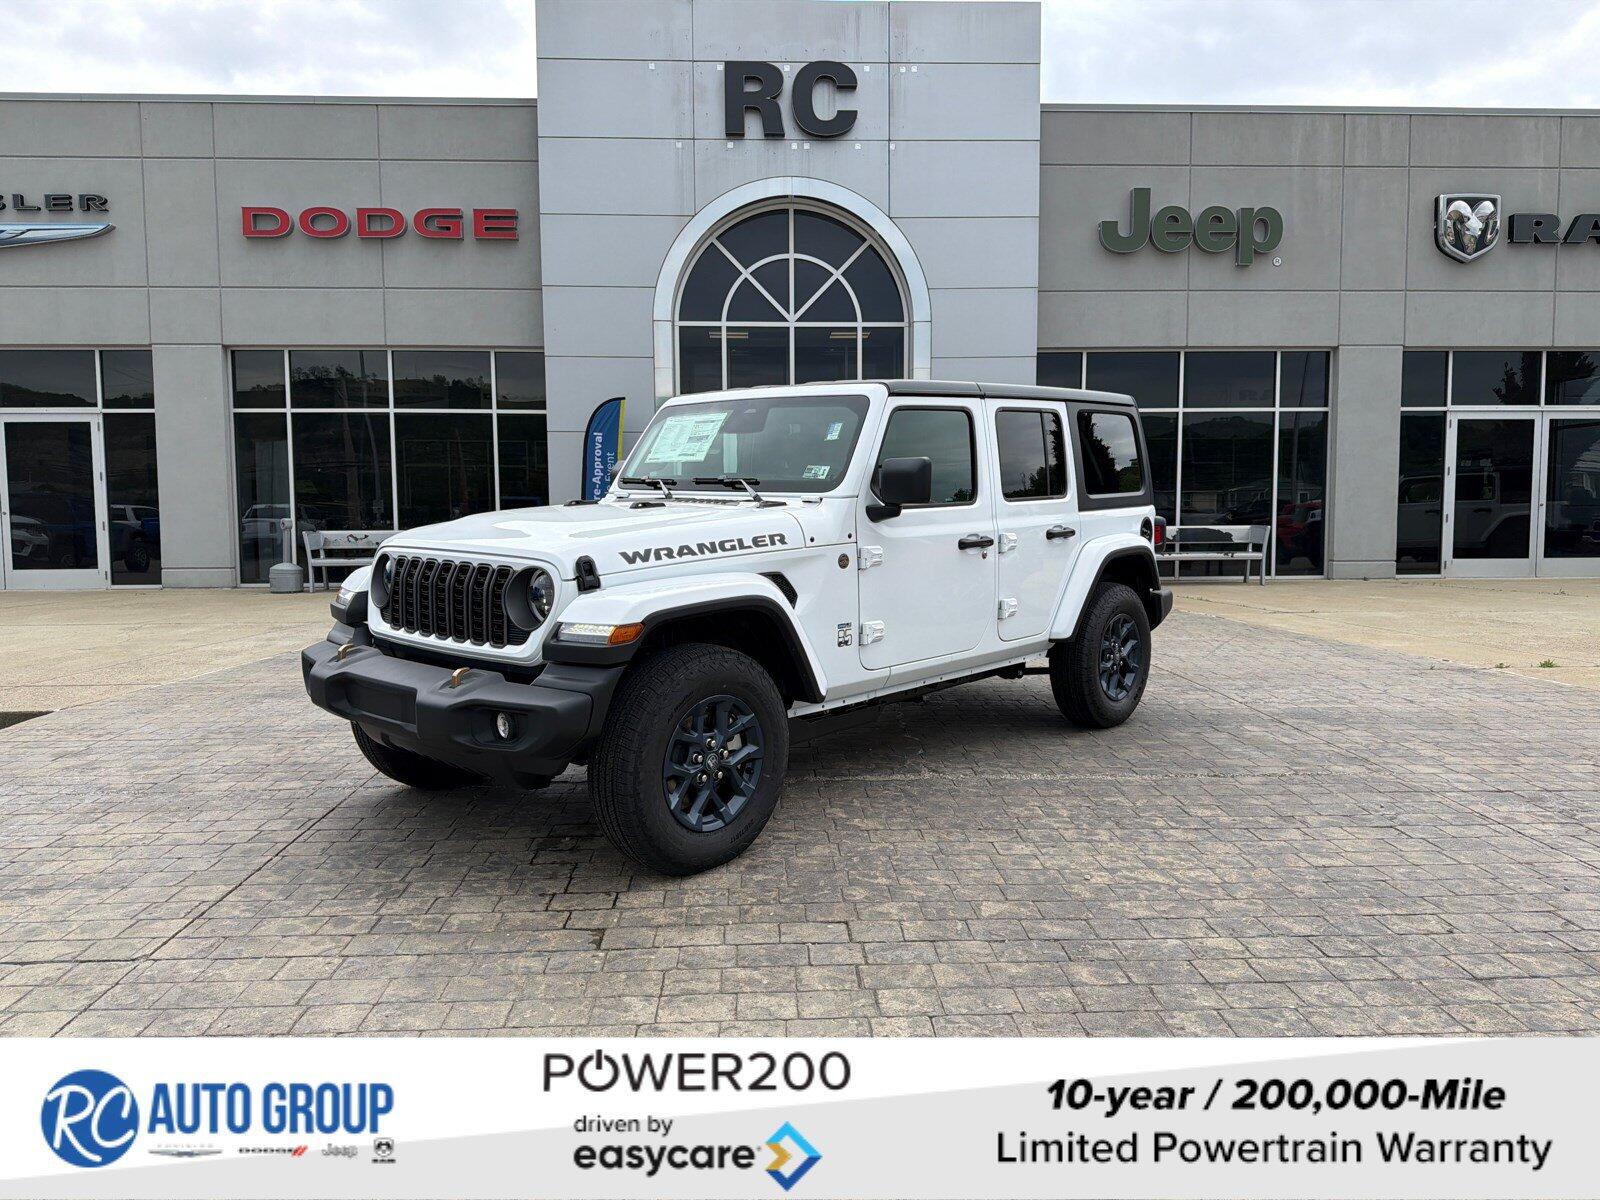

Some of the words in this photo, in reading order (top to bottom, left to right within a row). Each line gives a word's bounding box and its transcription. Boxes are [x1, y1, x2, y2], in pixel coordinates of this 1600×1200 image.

[725, 60, 858, 139] RC
[0, 193, 109, 212] LER
[241, 206, 519, 241] DODGE
[1099, 187, 1284, 267] Jeep
[618, 532, 789, 565] WRANGLER
